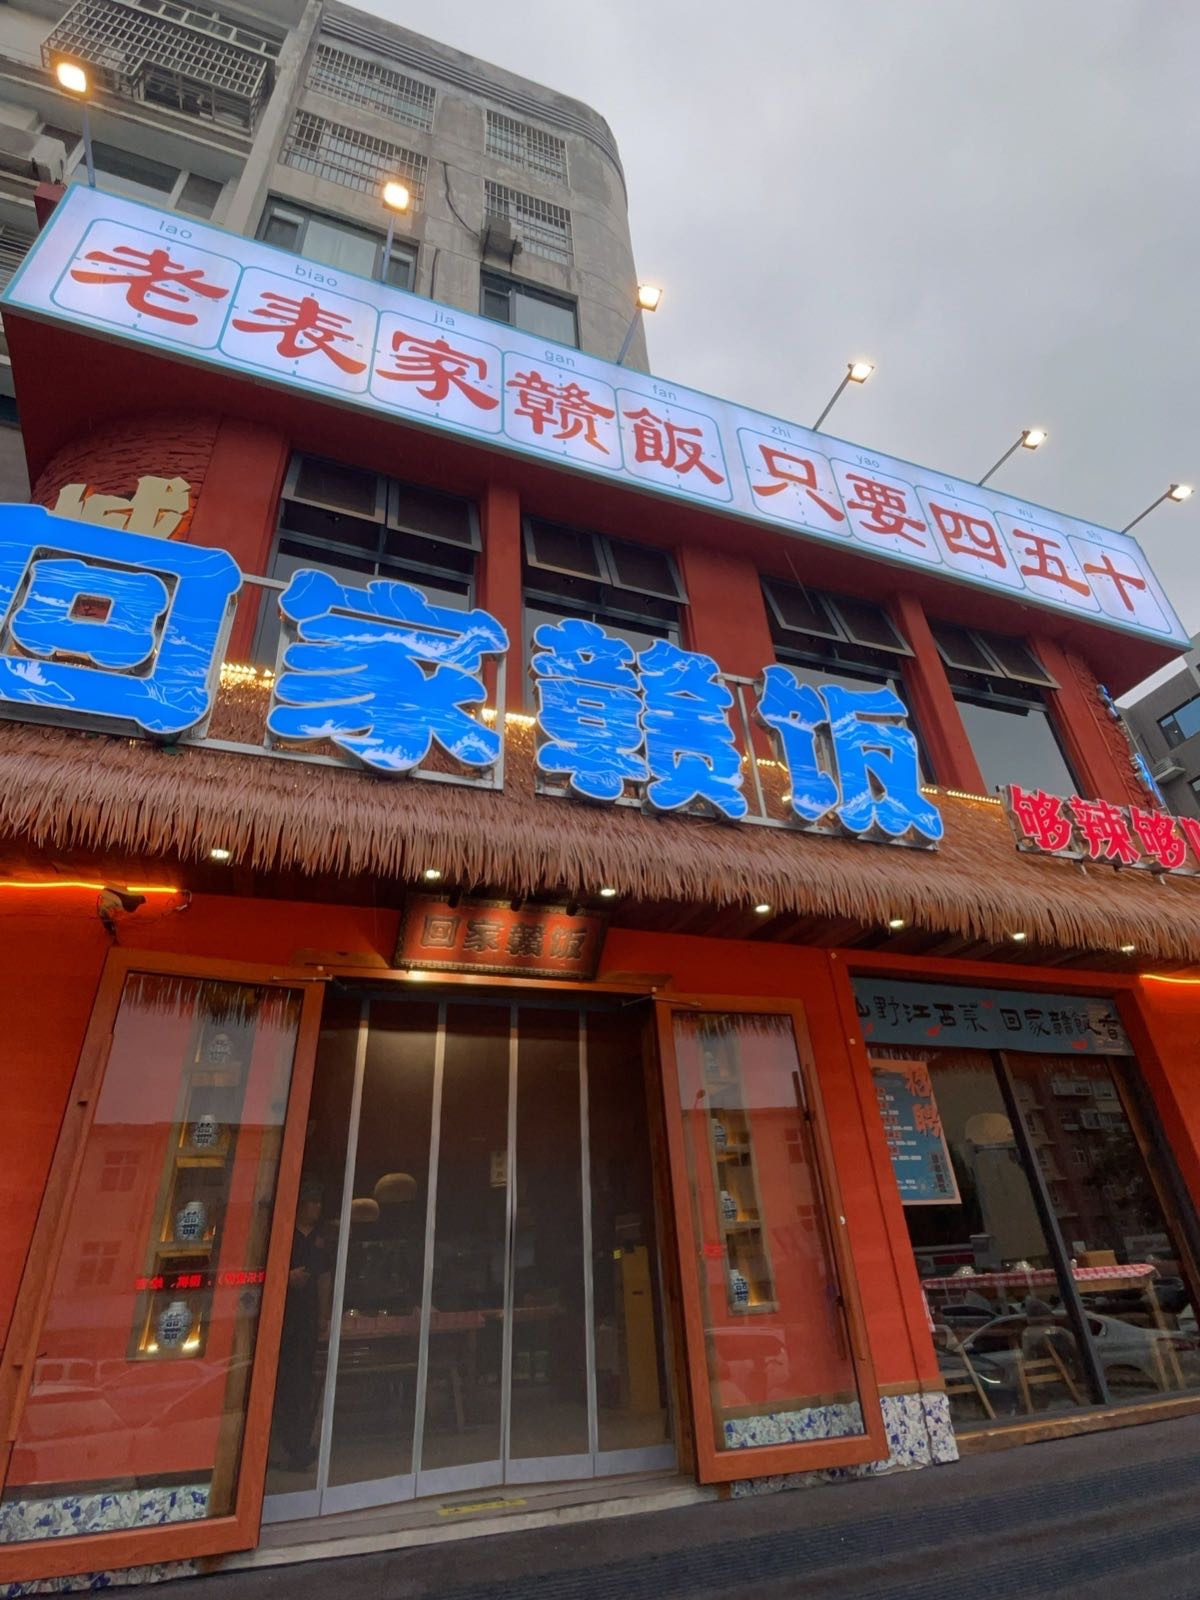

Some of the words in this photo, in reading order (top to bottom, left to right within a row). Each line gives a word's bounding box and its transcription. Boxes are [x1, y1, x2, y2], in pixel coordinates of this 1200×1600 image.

[158, 219, 194, 240] lao
[295, 263, 339, 288] biao
[432, 309, 456, 327] jia
[544, 350, 576, 368] gan
[651, 383, 678, 401] fan
[770, 425, 793, 440] zhi
[855, 454, 881, 469] yao
[752, 443, 1147, 614] 只要四五十
